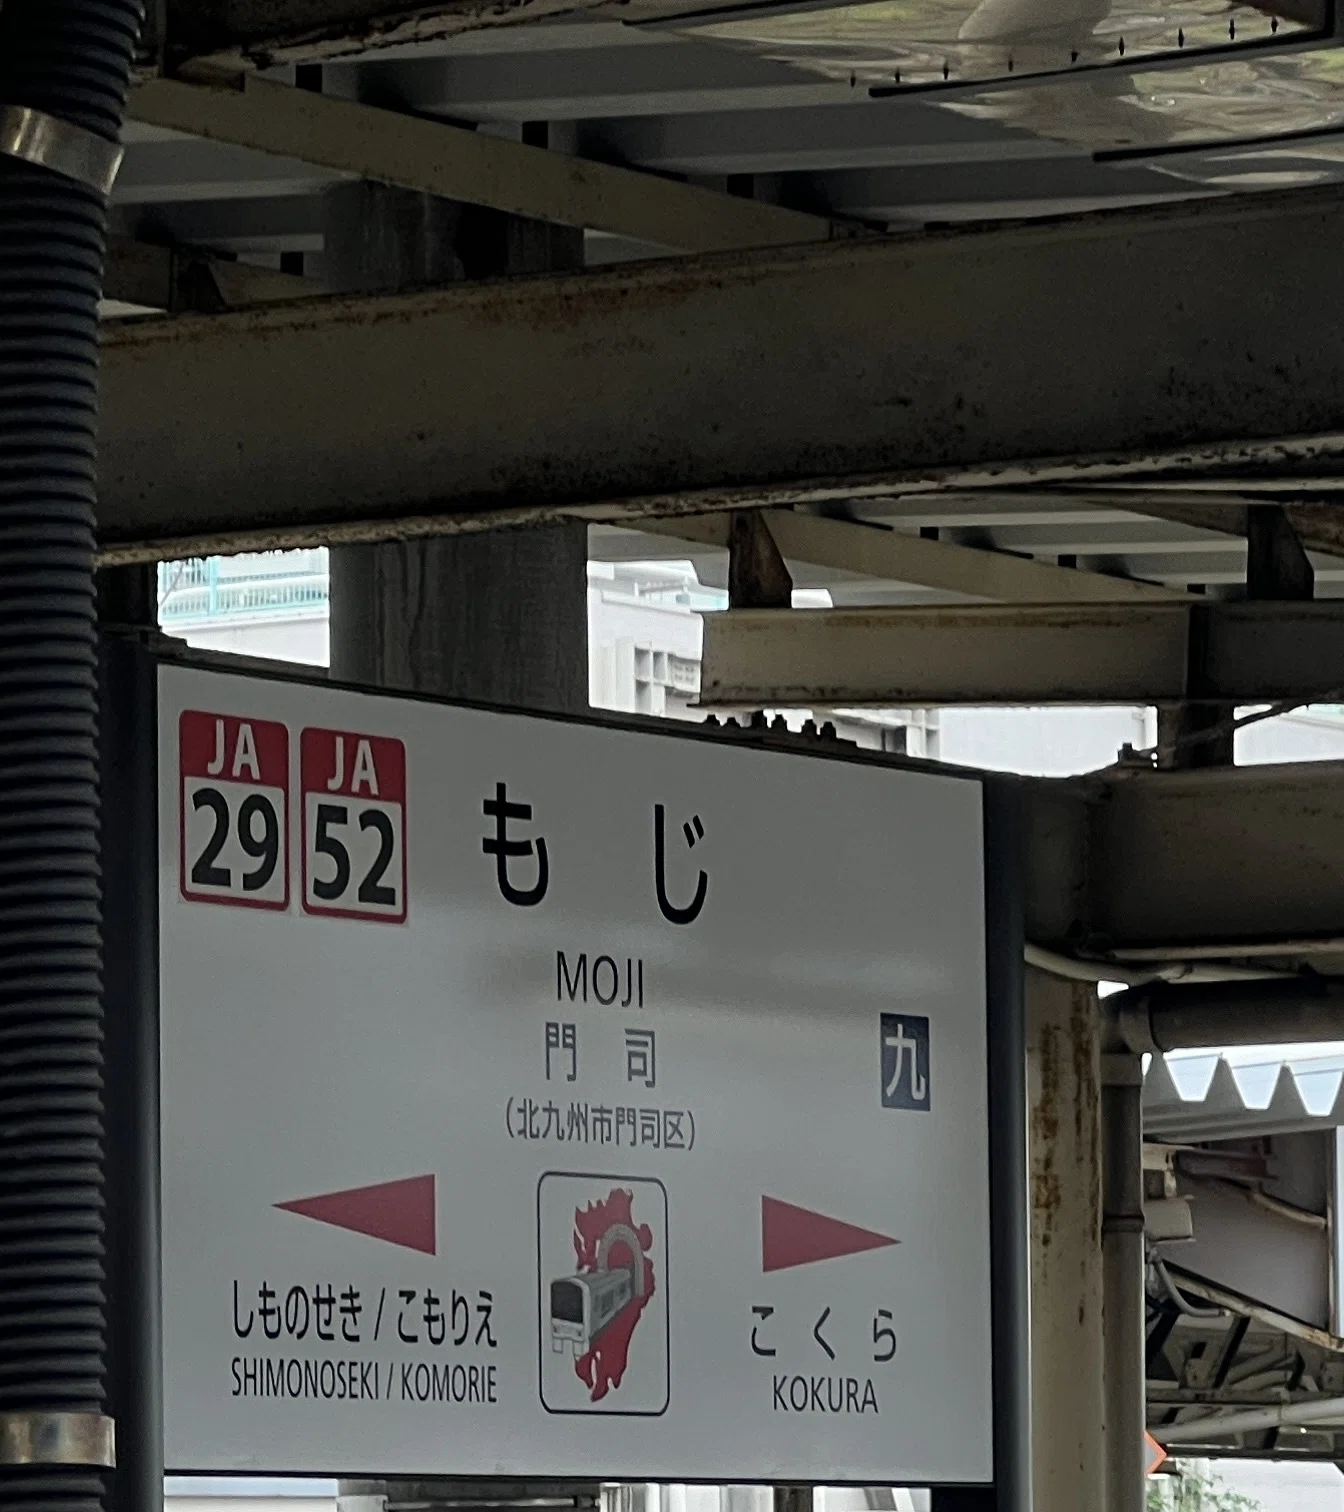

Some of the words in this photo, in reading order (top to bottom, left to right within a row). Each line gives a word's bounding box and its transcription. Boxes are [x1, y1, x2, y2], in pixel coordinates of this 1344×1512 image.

[208, 719, 260, 780] JA
[327, 736, 379, 795] JA
[191, 788, 279, 891] 29
[313, 804, 397, 905] 52
[482, 782, 708, 924] もじ
[557, 951, 643, 1008] MOJI
[545, 1022, 656, 1088] 門司
[885, 1024, 926, 1100] 九
[233, 1280, 362, 1342] しものせき
[398, 1288, 497, 1347] こもりえ
[751, 1306, 896, 1361] こくら
[232, 1357, 378, 1399] SHIMONOSEKI
[402, 1363, 497, 1402] KOMORIE
[773, 1375, 879, 1413] KOKURA
